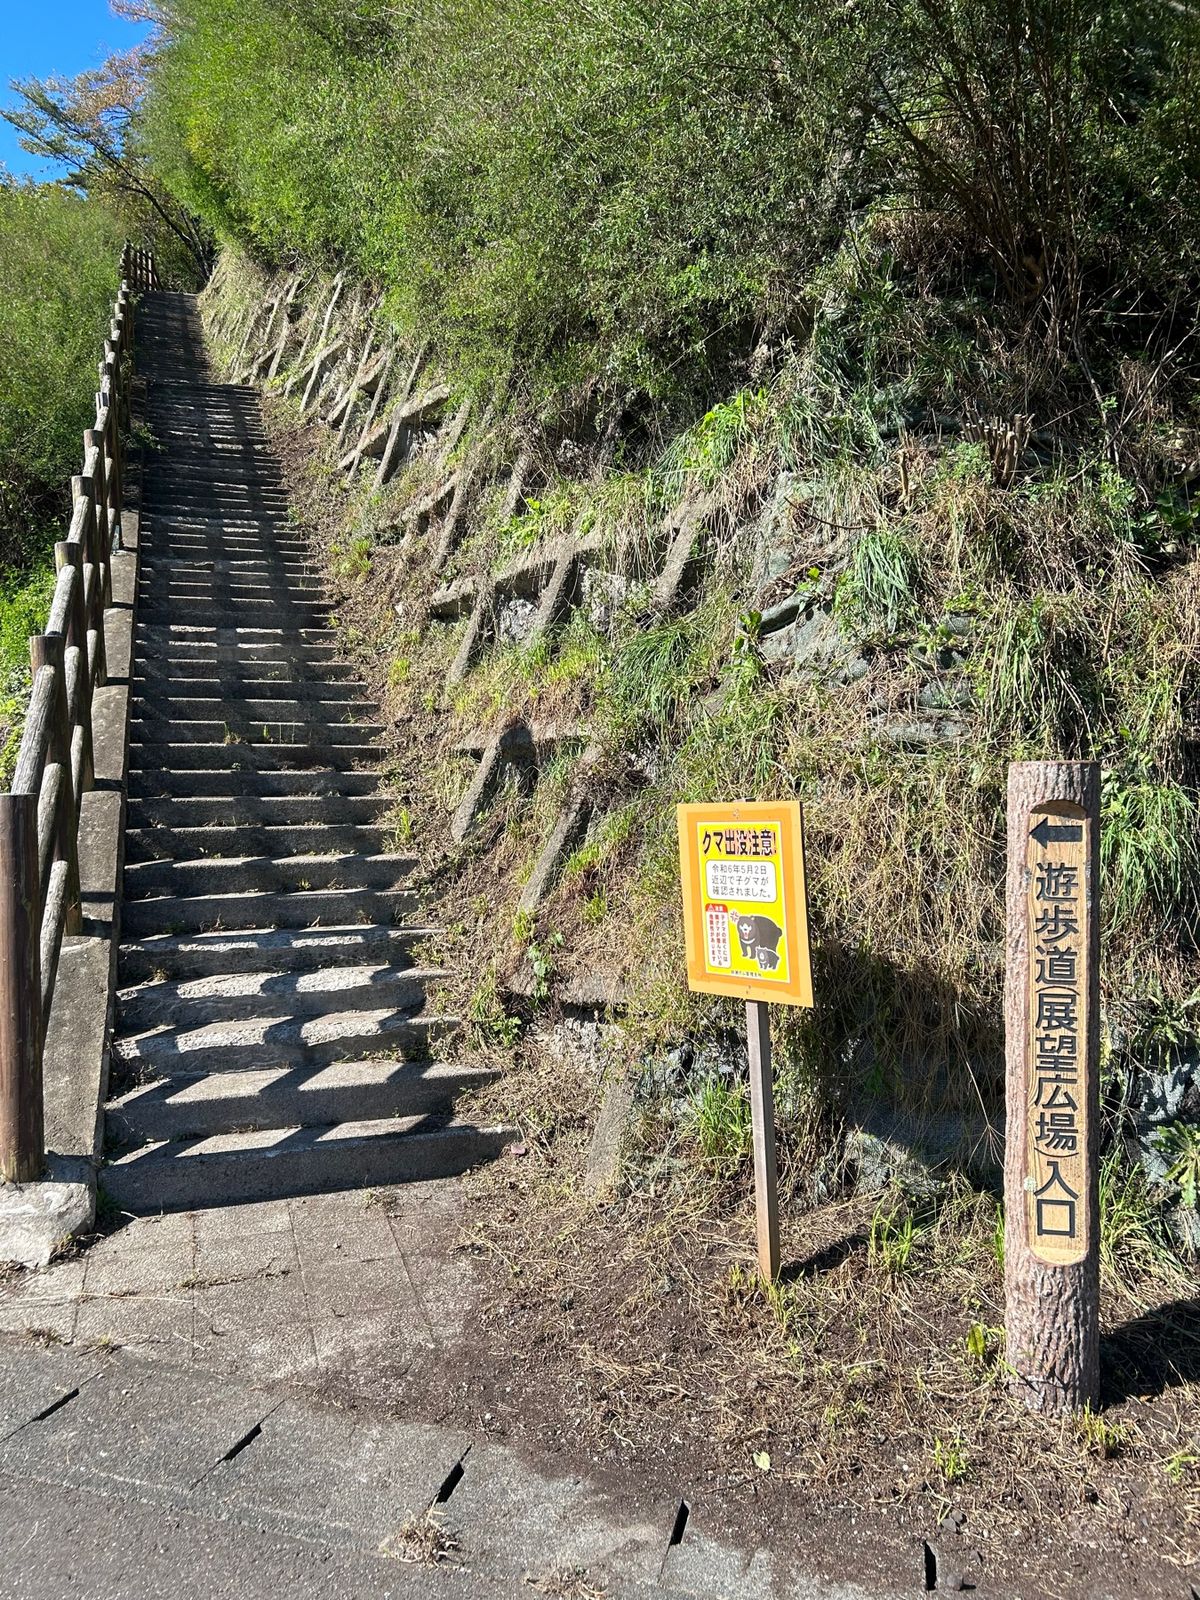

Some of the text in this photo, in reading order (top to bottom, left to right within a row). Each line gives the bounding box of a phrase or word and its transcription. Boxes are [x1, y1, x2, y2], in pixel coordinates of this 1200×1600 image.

[703, 829, 777, 856] クマ出没注意!
[712, 863, 767, 875] 令和6年5月2日
[712, 875, 769, 886] 近辺で子グマが
[712, 886, 771, 898] 確認されました。
[1034, 862, 1080, 1239] 遊歩道(展望広場)入口
